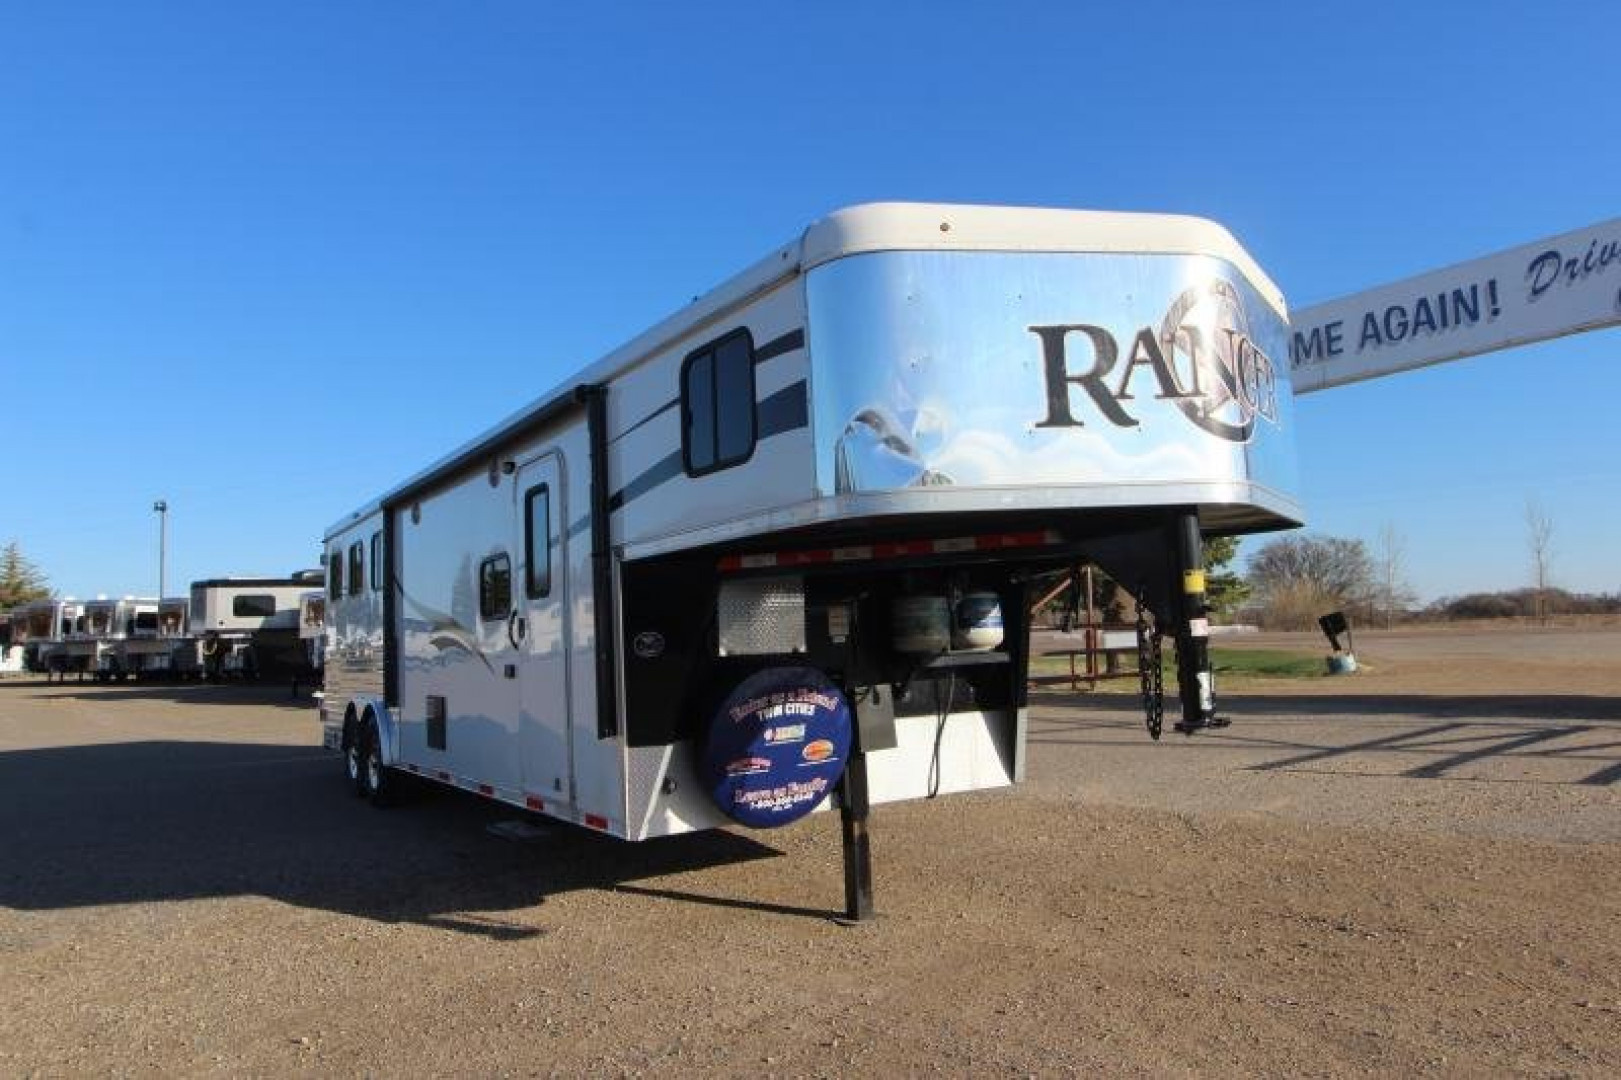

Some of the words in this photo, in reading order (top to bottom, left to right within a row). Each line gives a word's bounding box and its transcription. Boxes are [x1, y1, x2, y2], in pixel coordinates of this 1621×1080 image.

[1289, 320, 1344, 366] ME
[1359, 279, 1500, 348] AGAIN!
[1028, 323, 1278, 428] RANGER
